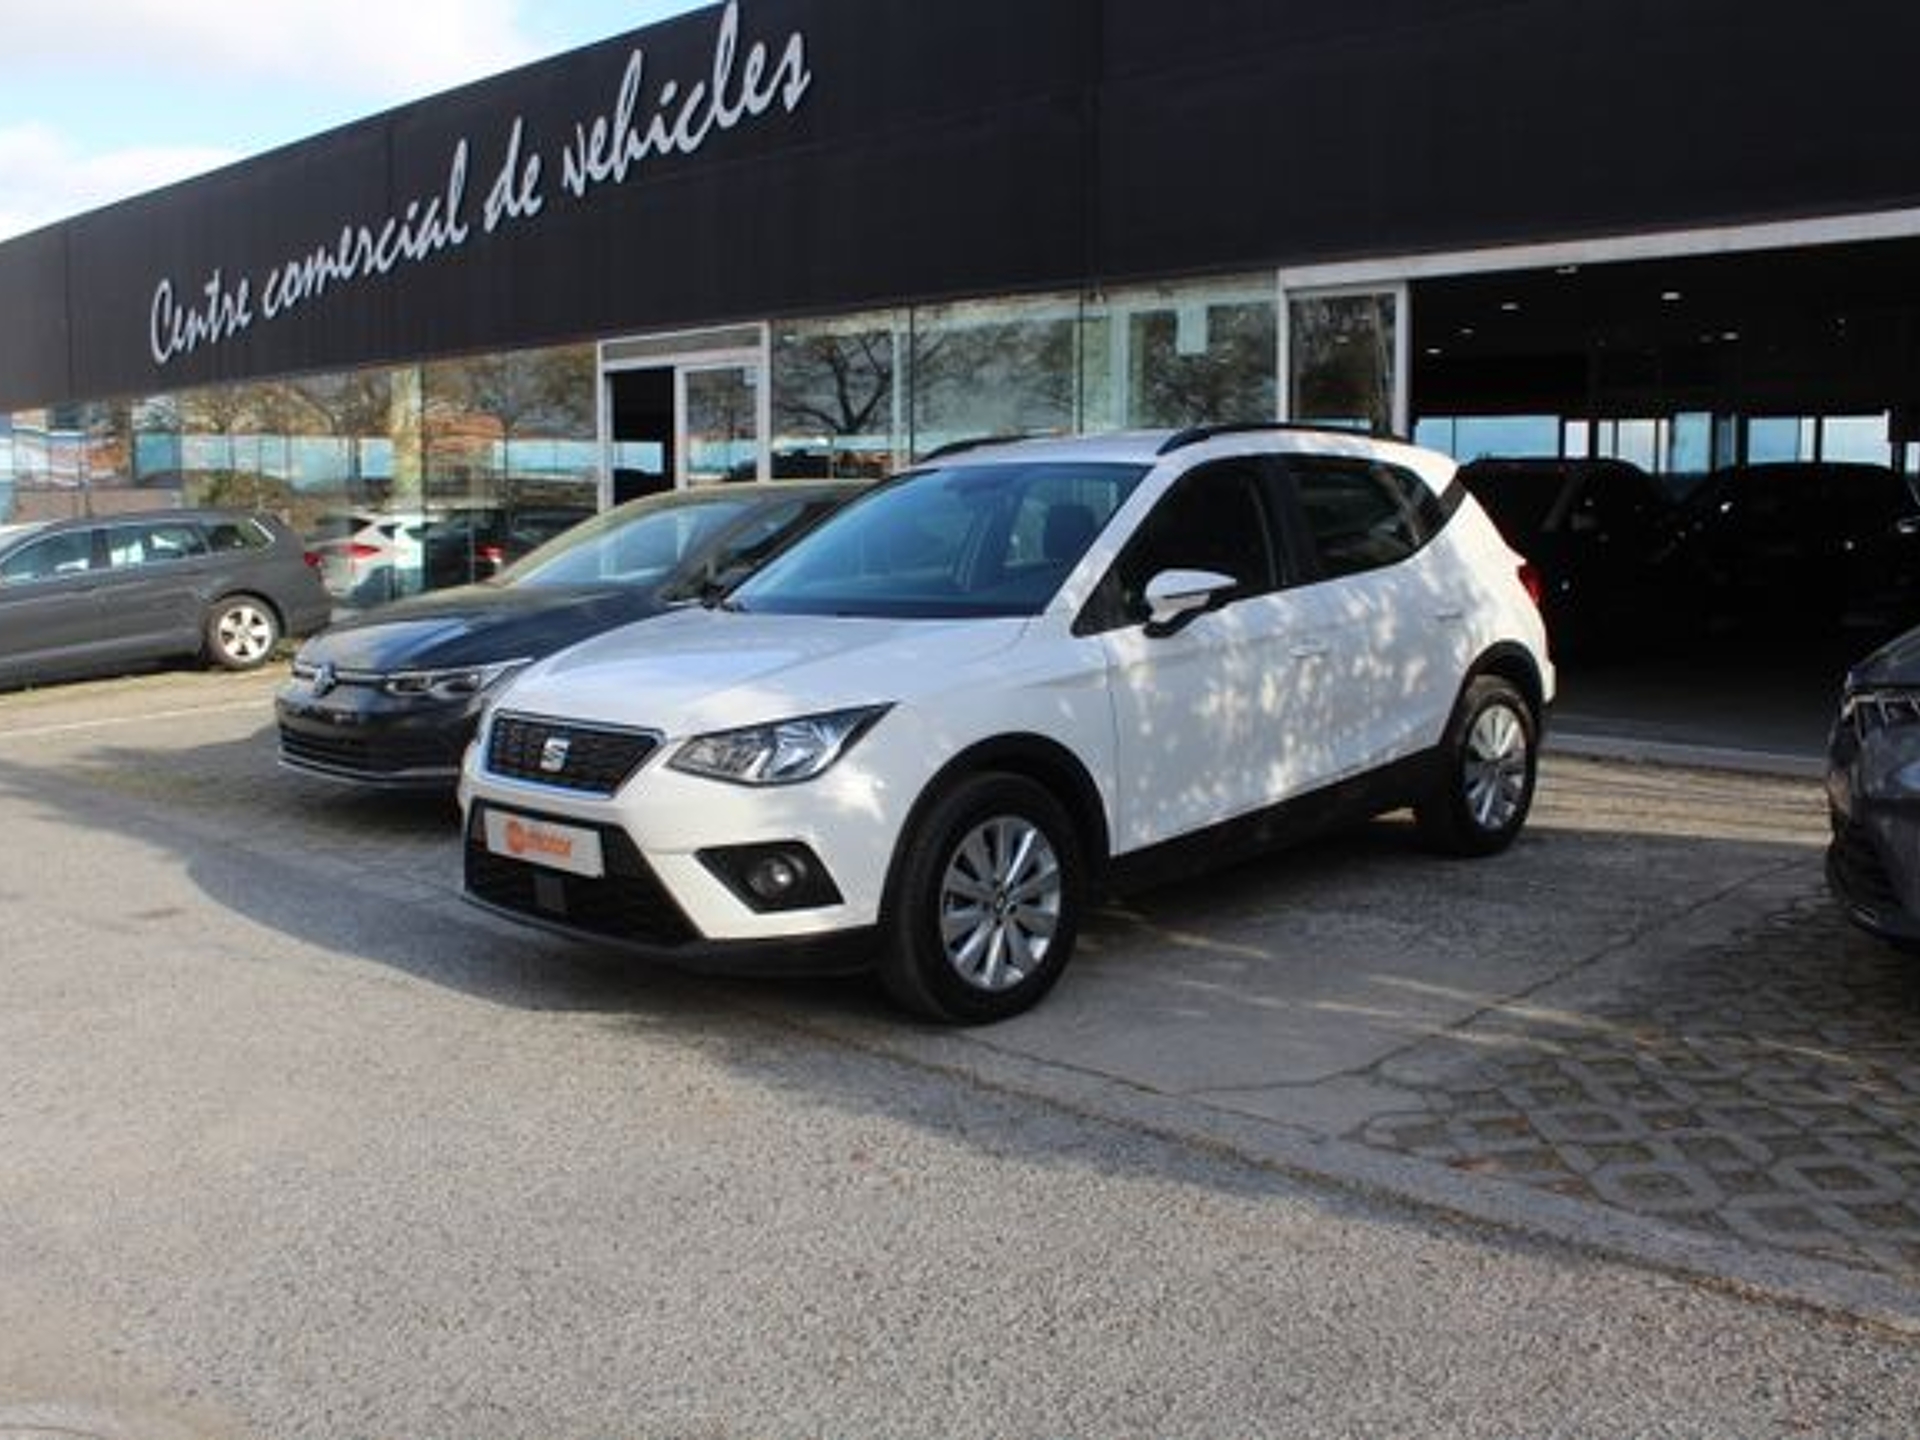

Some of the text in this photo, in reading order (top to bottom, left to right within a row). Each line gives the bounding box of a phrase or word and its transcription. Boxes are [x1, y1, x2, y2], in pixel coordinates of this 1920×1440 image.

[149, 0, 812, 366] Centre comercial de vehicles
